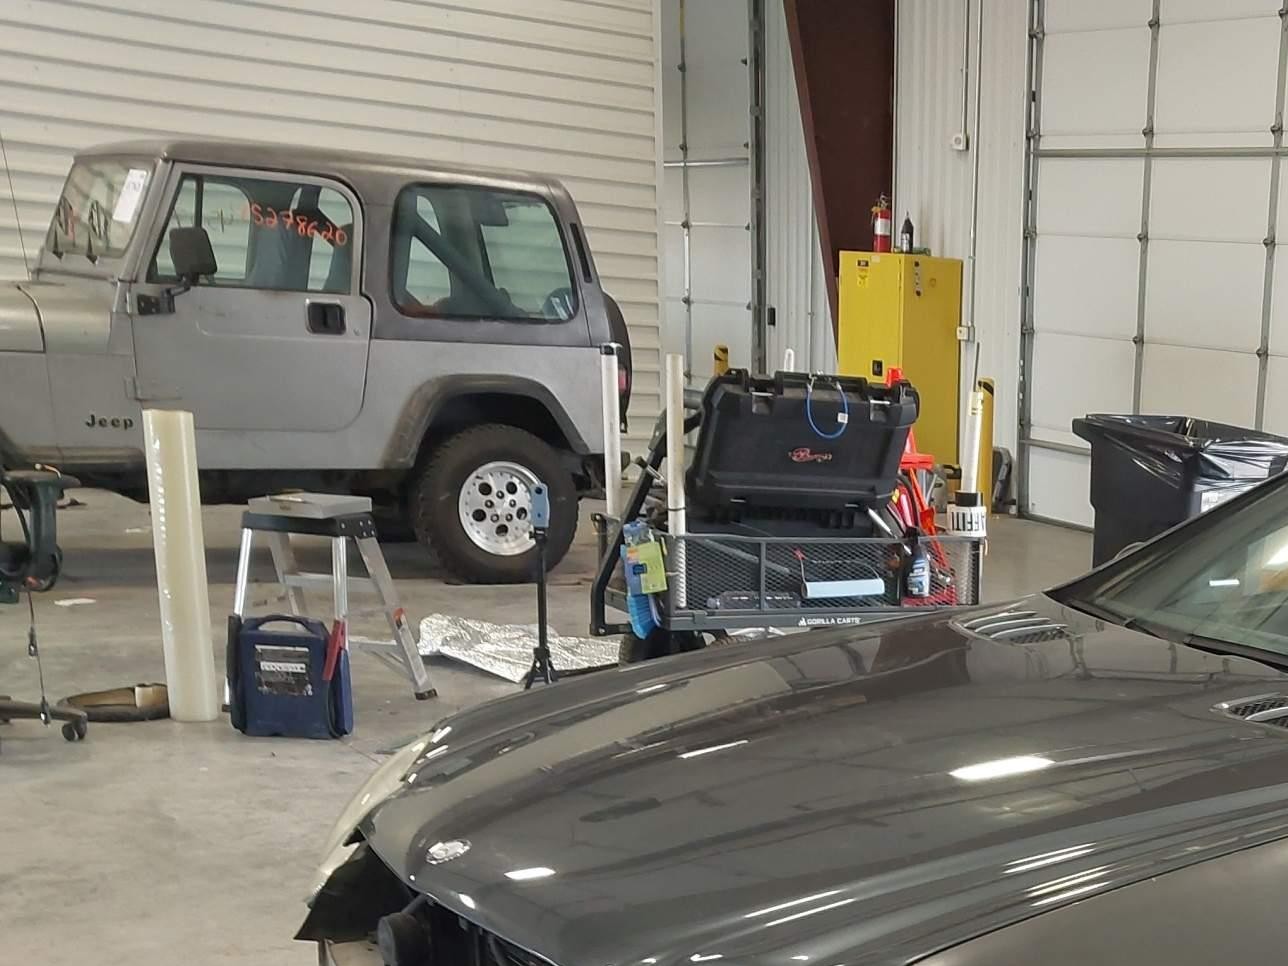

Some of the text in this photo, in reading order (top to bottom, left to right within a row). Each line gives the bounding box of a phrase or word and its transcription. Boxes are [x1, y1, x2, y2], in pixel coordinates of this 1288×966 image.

[85, 413, 134, 431] Jeep
[807, 616, 860, 625] GORILLA CARTS
